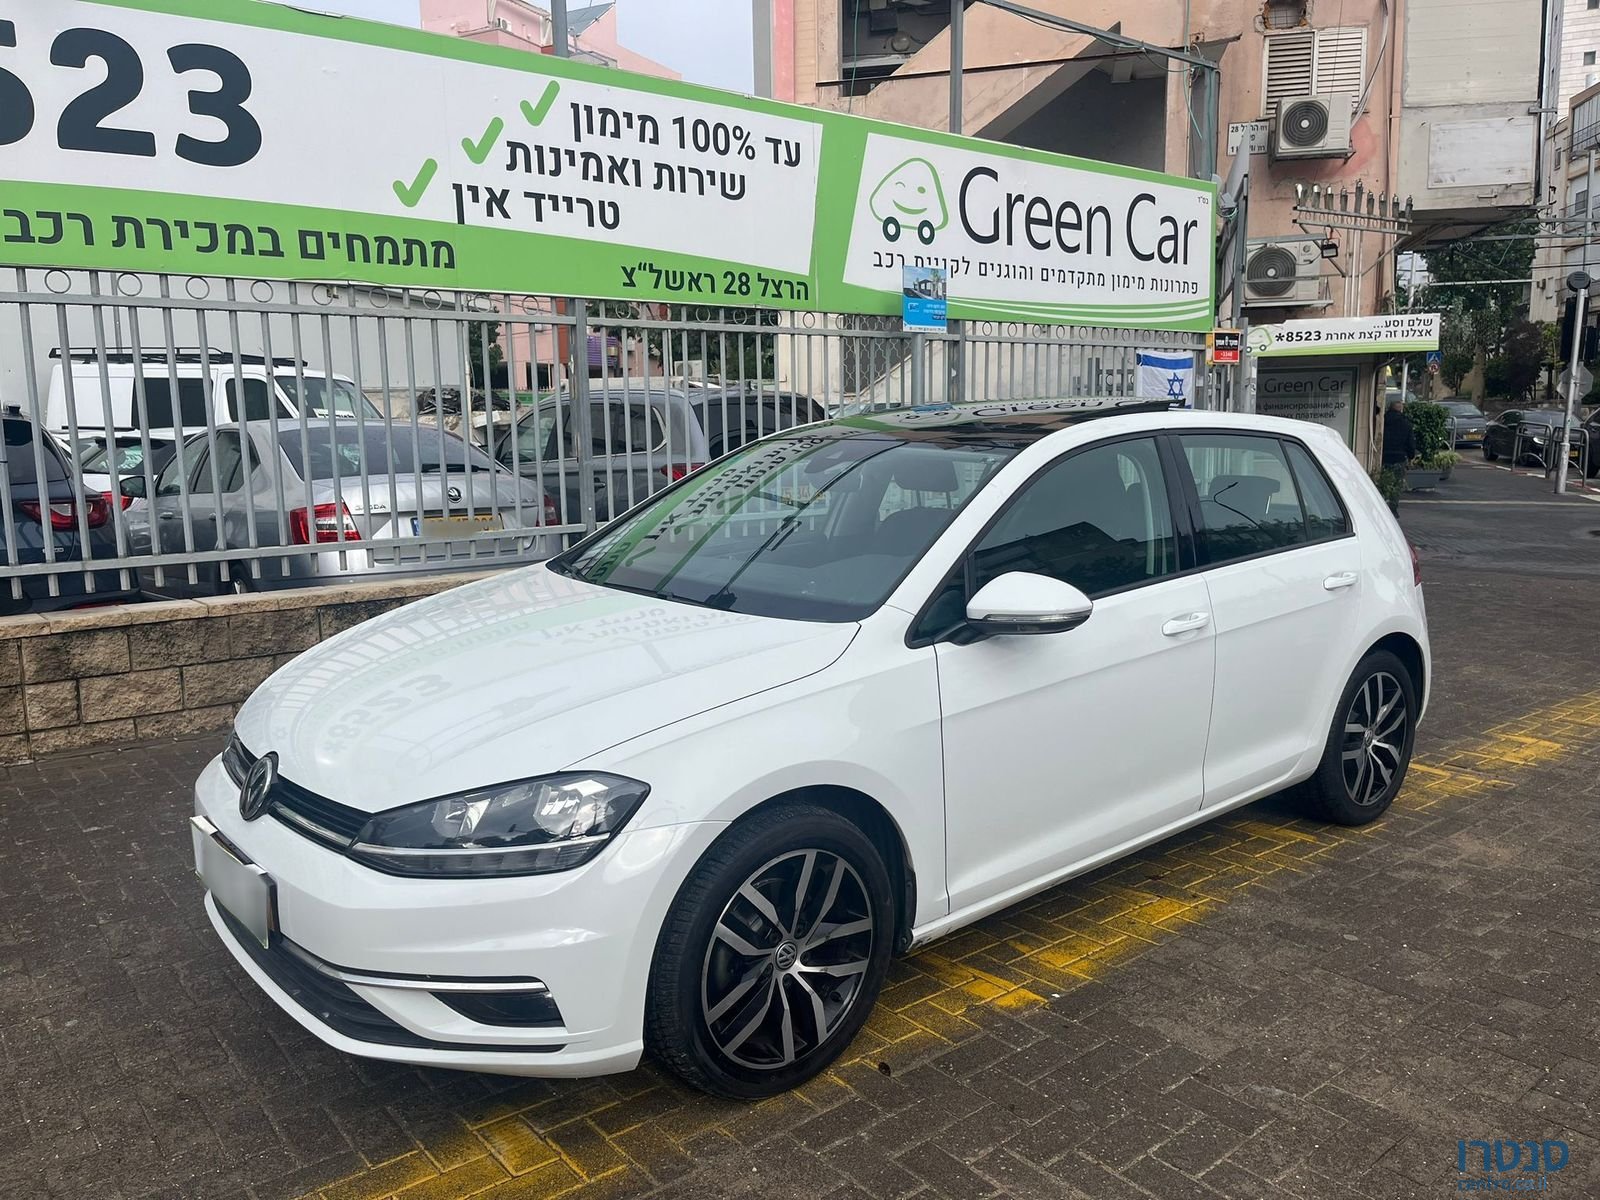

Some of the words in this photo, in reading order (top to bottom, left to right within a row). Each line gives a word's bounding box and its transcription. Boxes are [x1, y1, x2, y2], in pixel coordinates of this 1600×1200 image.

[570, 102, 660, 145] מימון
[672, 115, 756, 160] 100%
[505, 140, 641, 187] ואמינות
[765, 136, 801, 168] עד
[653, 162, 746, 201] שירות
[452, 182, 512, 225] אין
[523, 190, 620, 230] טרייד
[958, 166, 1112, 257] Green
[1126, 192, 1198, 265] Car
[2, 208, 95, 246] רכב
[111, 215, 285, 258] במכירת
[298, 229, 456, 269] מתמחים
[873, 251, 905, 268] רכב
[722, 270, 751, 297] 28
[978, 260, 1034, 281] והוגנים
[1040, 267, 1106, 288] מתקדמים
[1111, 274, 1145, 292] מימון
[757, 271, 809, 301] הרצל
[1150, 278, 1199, 295] פתרונות
[1325, 331, 1355, 341] אחרת
[1358, 329, 1382, 341] קצת
[1385, 329, 1398, 338] זה
[1401, 328, 1433, 338] אצלנו
[1407, 317, 1433, 328] שלם
[1264, 378, 1314, 393] Green
[1319, 376, 1347, 392] Car
[1333, 401, 1346, 411] до
